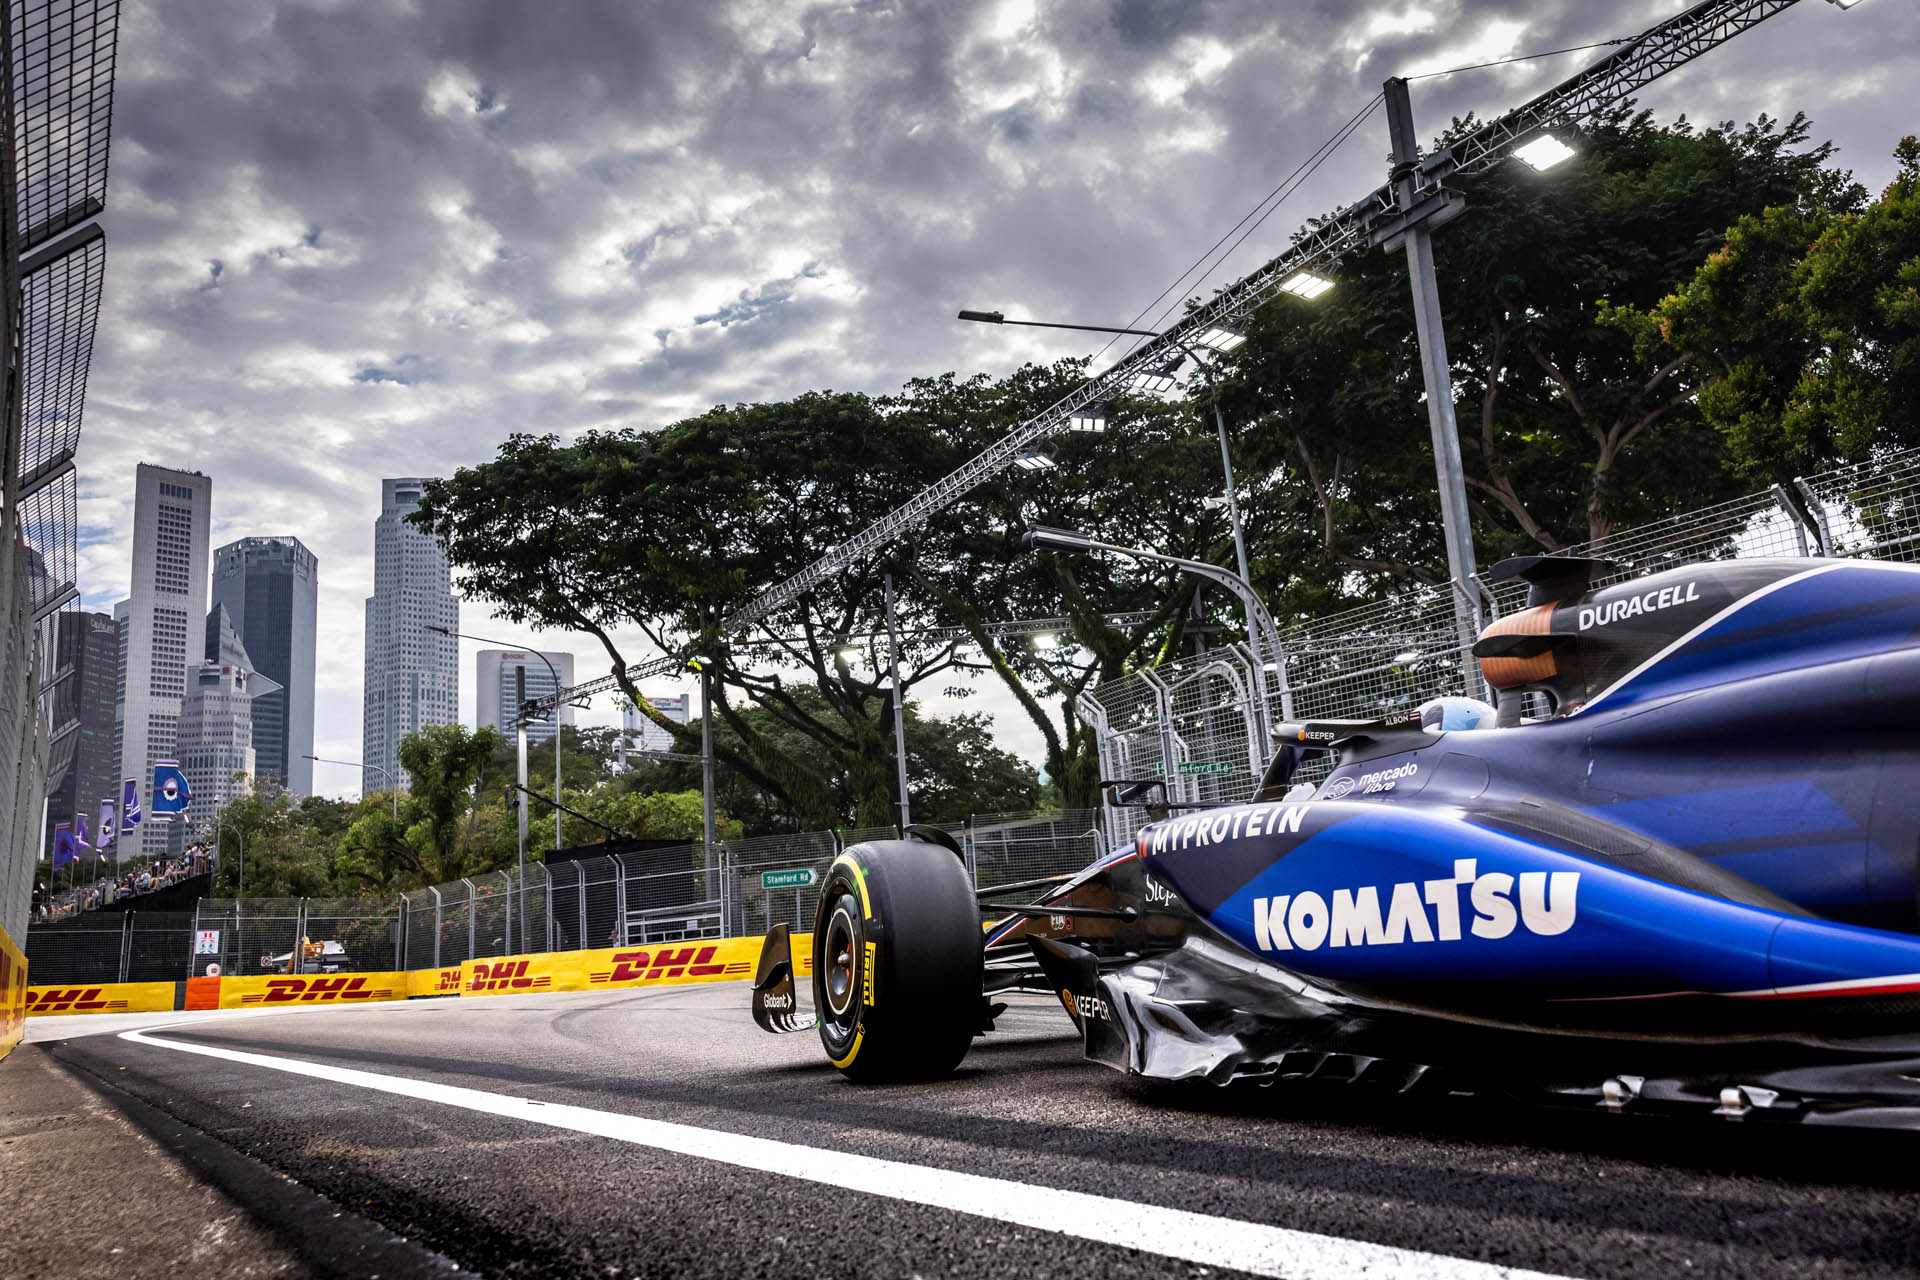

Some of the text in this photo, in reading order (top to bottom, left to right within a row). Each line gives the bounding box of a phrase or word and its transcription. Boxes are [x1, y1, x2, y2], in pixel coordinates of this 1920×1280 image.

[1579, 582, 1700, 630] DURACELL
[1386, 714, 1409, 726] ALBON
[1305, 731, 1335, 740] KEEPER
[1359, 762, 1418, 785] mercado
[1363, 781, 1396, 794] libre
[1152, 806, 1311, 855] MYPROTEIN
[767, 872, 809, 884] Stamford Rd
[1254, 858, 1580, 950] KOMATSU
[472, 960, 533, 991] DHL
[610, 946, 726, 982] DHL
[263, 977, 374, 1002] DHL
[763, 993, 788, 1009] Globant
[1073, 994, 1112, 1021] KEEPER
